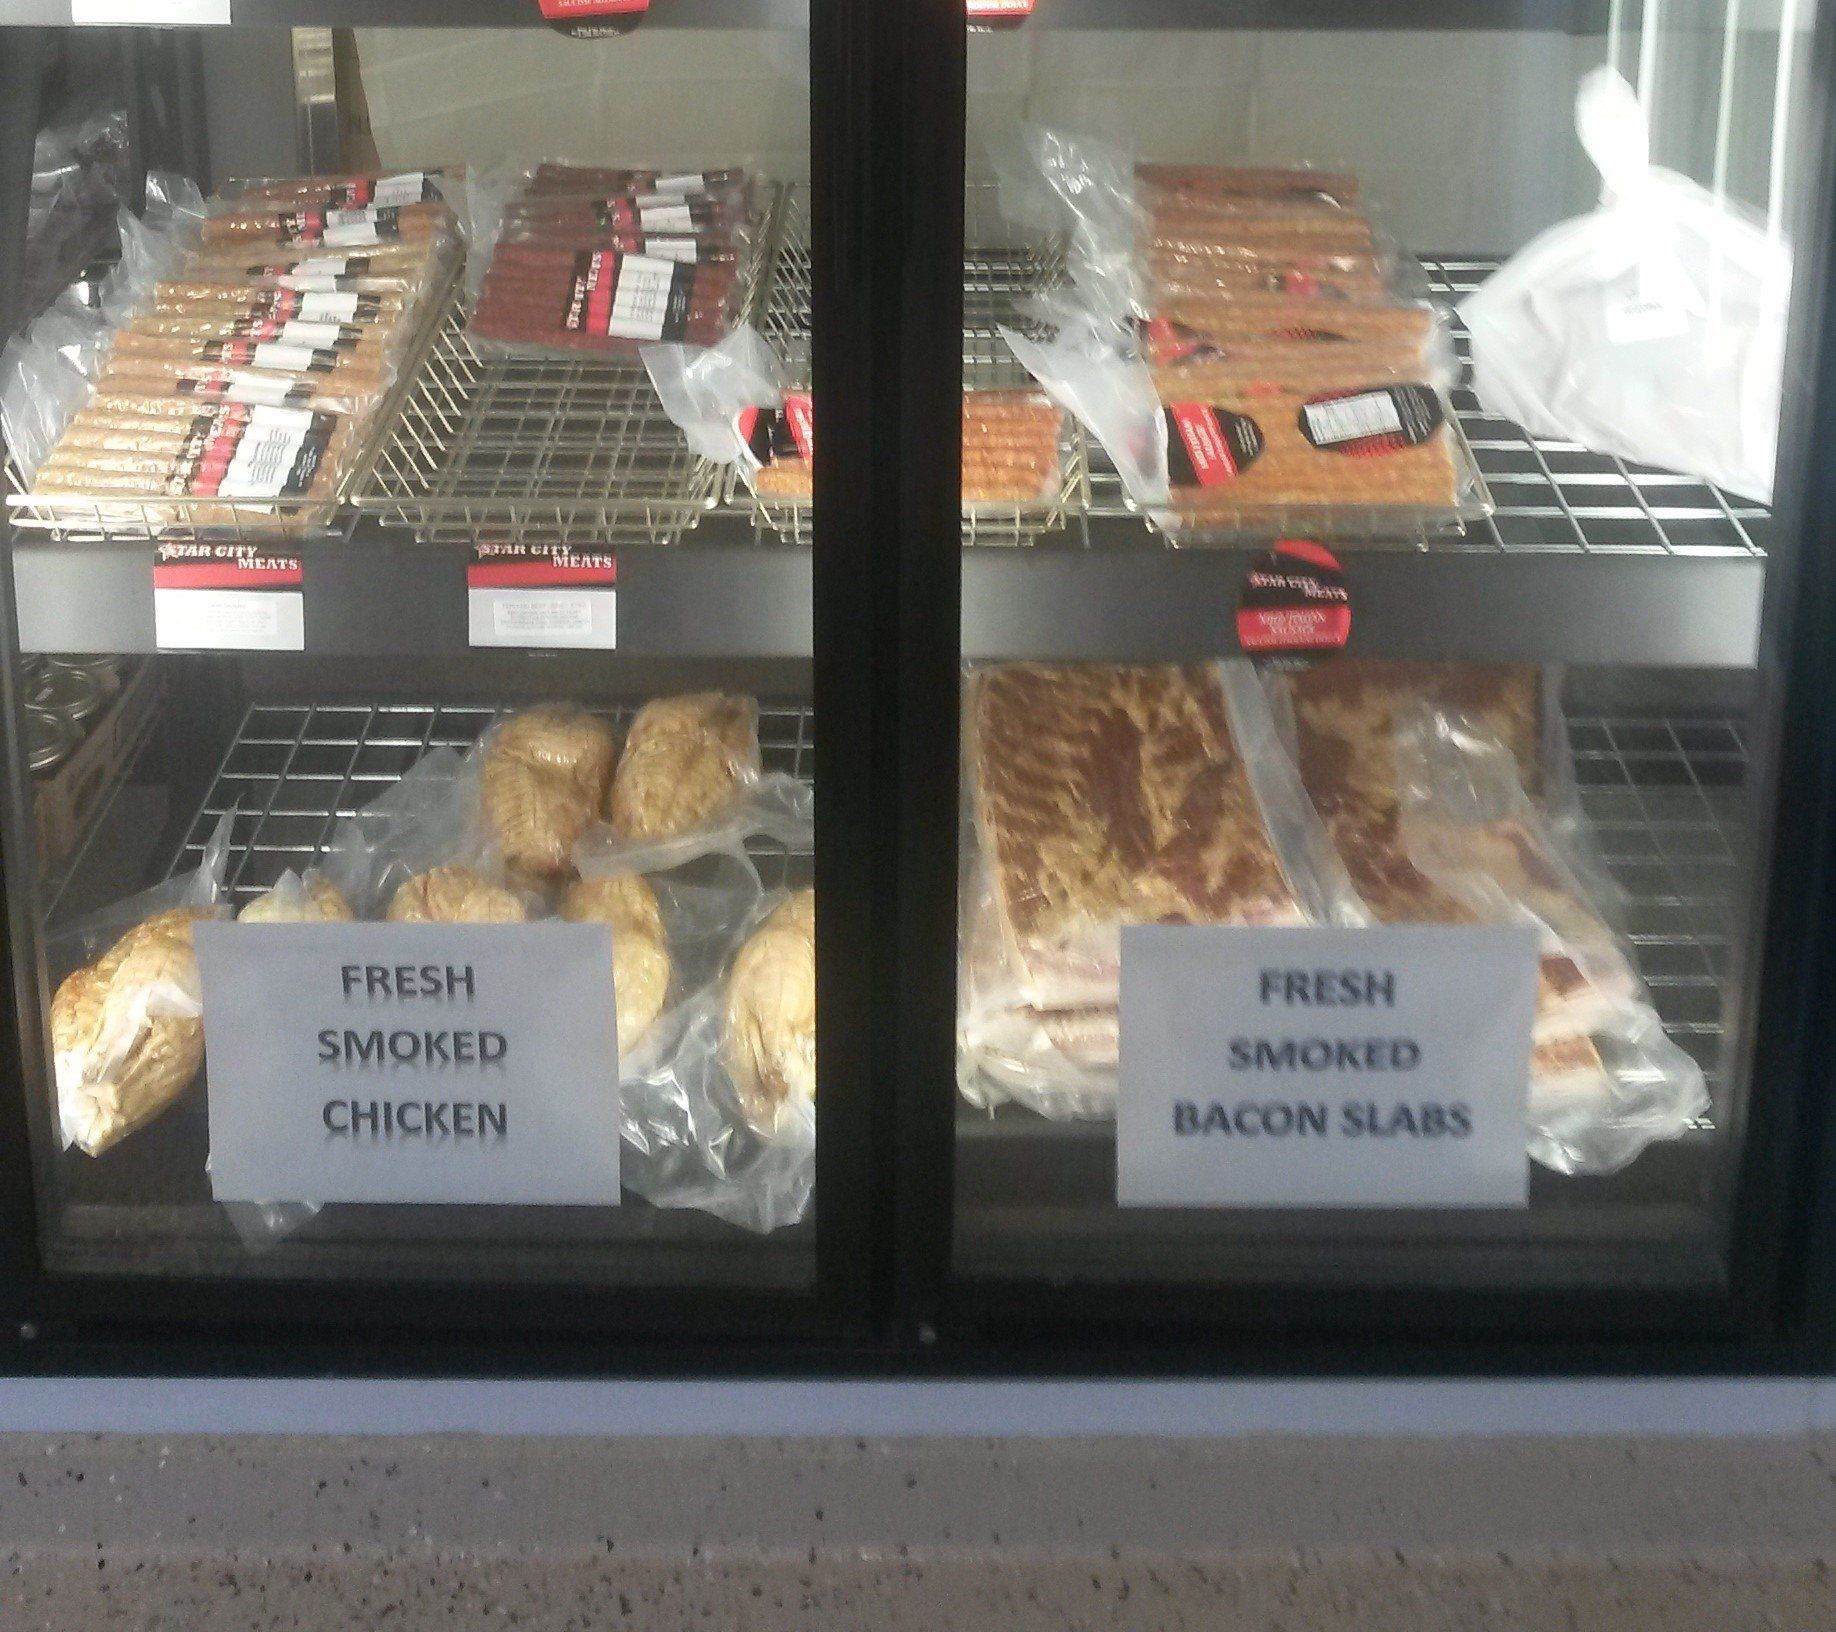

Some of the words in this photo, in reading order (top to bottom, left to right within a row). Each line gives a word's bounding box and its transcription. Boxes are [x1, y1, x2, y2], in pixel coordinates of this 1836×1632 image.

[215, 544, 258, 558] CITY
[237, 557, 299, 570] MEATS
[481, 543, 526, 556] STAR
[530, 544, 573, 556] CITY
[552, 555, 612, 569] MEATS
[340, 964, 476, 1000] FRESH
[1258, 968, 1396, 1007] FRESH
[317, 1029, 509, 1064] SMOKED
[1227, 1035, 1422, 1072] SMOKED
[321, 1100, 509, 1137] CHICKEN
[1171, 1099, 1329, 1138] BACON
[1340, 1100, 1474, 1140] SLABS
